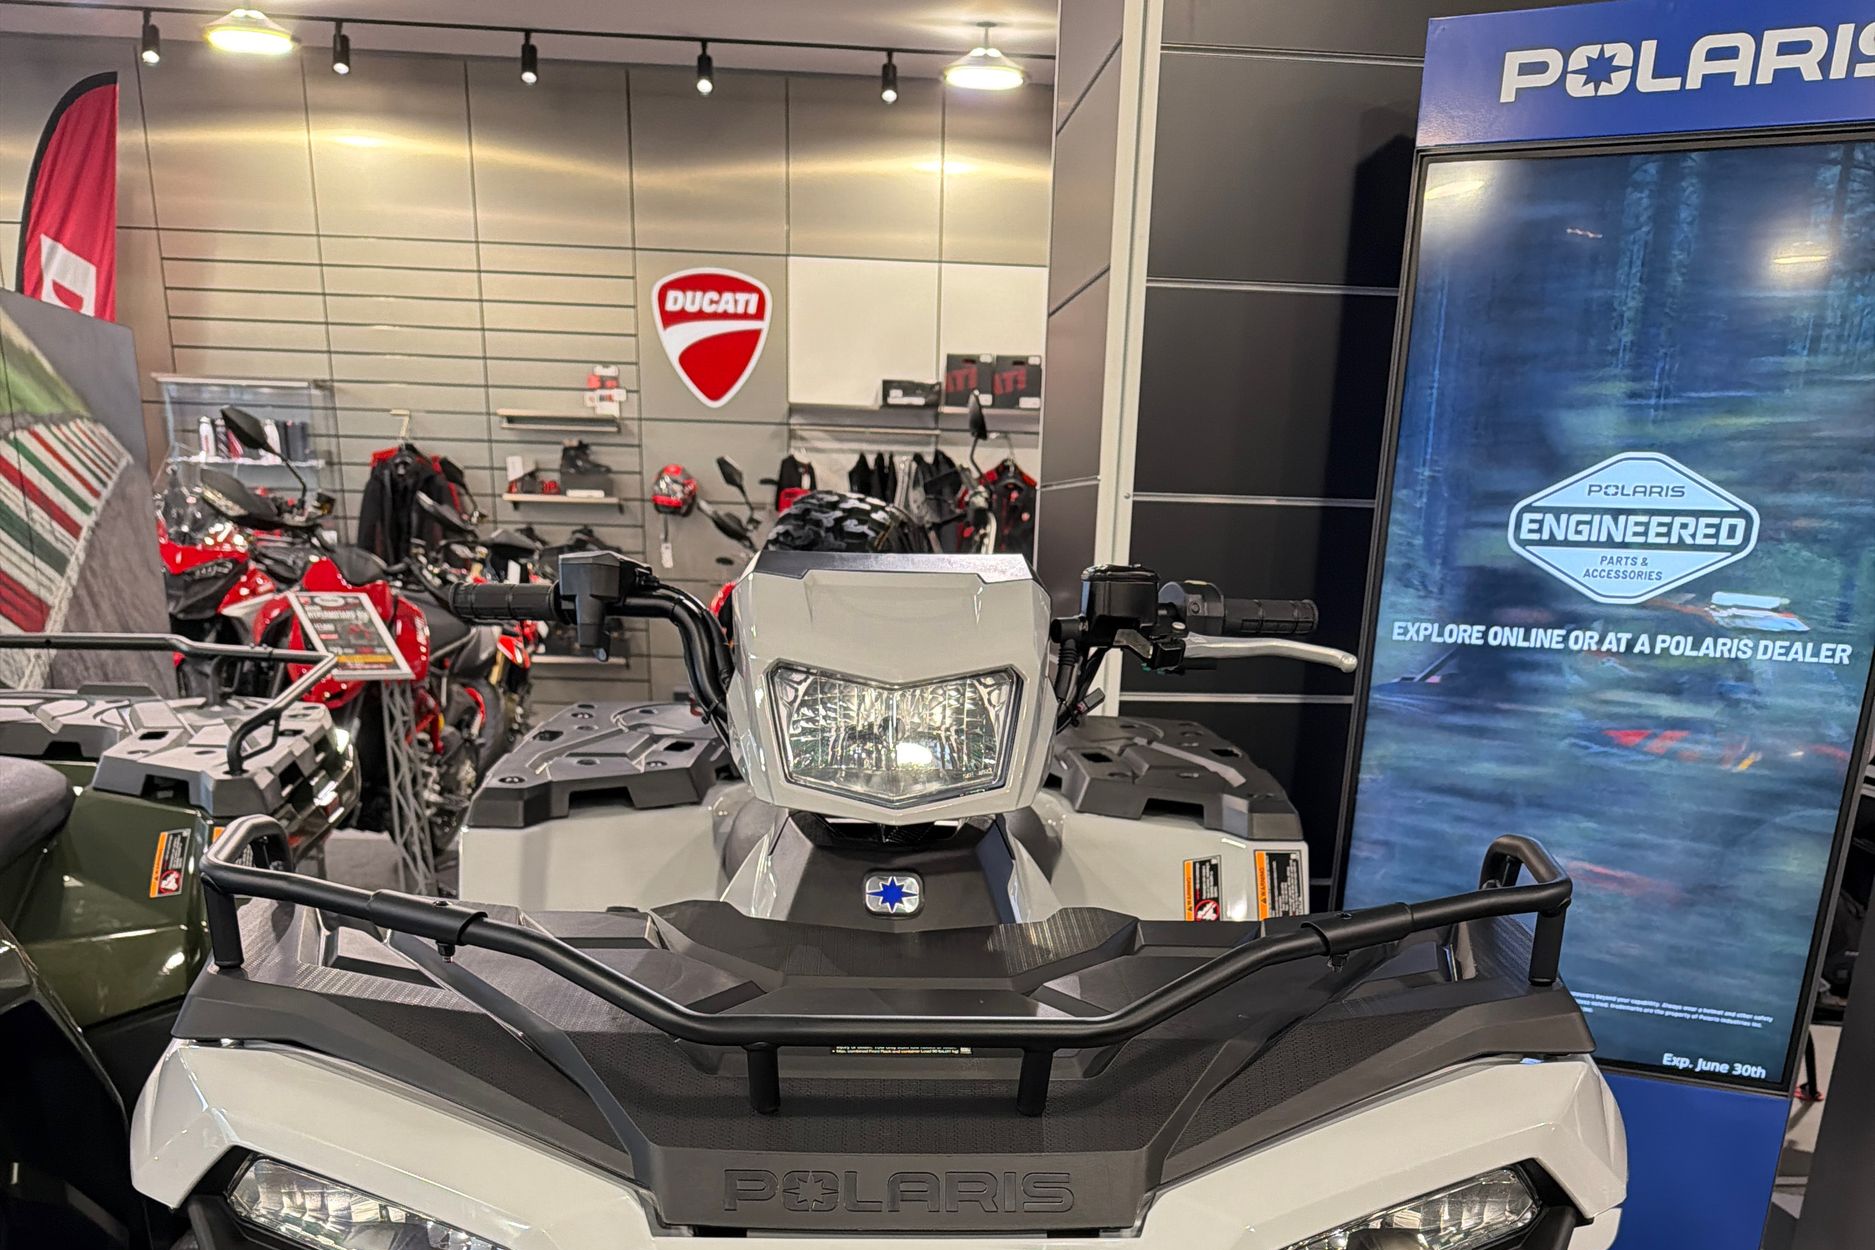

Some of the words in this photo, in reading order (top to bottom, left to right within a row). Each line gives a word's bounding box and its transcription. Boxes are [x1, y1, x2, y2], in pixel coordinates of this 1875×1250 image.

[664, 289, 760, 315] DUCATI
[1586, 483, 1686, 498] POLARIS
[1519, 512, 1747, 546] ENGINEERED
[1599, 555, 1638, 567] PARTS
[1640, 556, 1649, 567] &
[1582, 568, 1663, 581] ACCESSORIES
[1391, 621, 1487, 645] EXPLORE
[1487, 626, 1567, 650] ONLINE
[1568, 630, 1599, 651] OR
[1600, 631, 1633, 653] AT
[1632, 633, 1651, 655] A
[1654, 634, 1754, 660] POLARIS
[1755, 639, 1853, 665] DEALER
[1662, 1052, 1694, 1069] Exp.
[1695, 1058, 1730, 1073] June
[1731, 1062, 1767, 1079] 30th
[723, 1168, 1076, 1214] POLARIS
